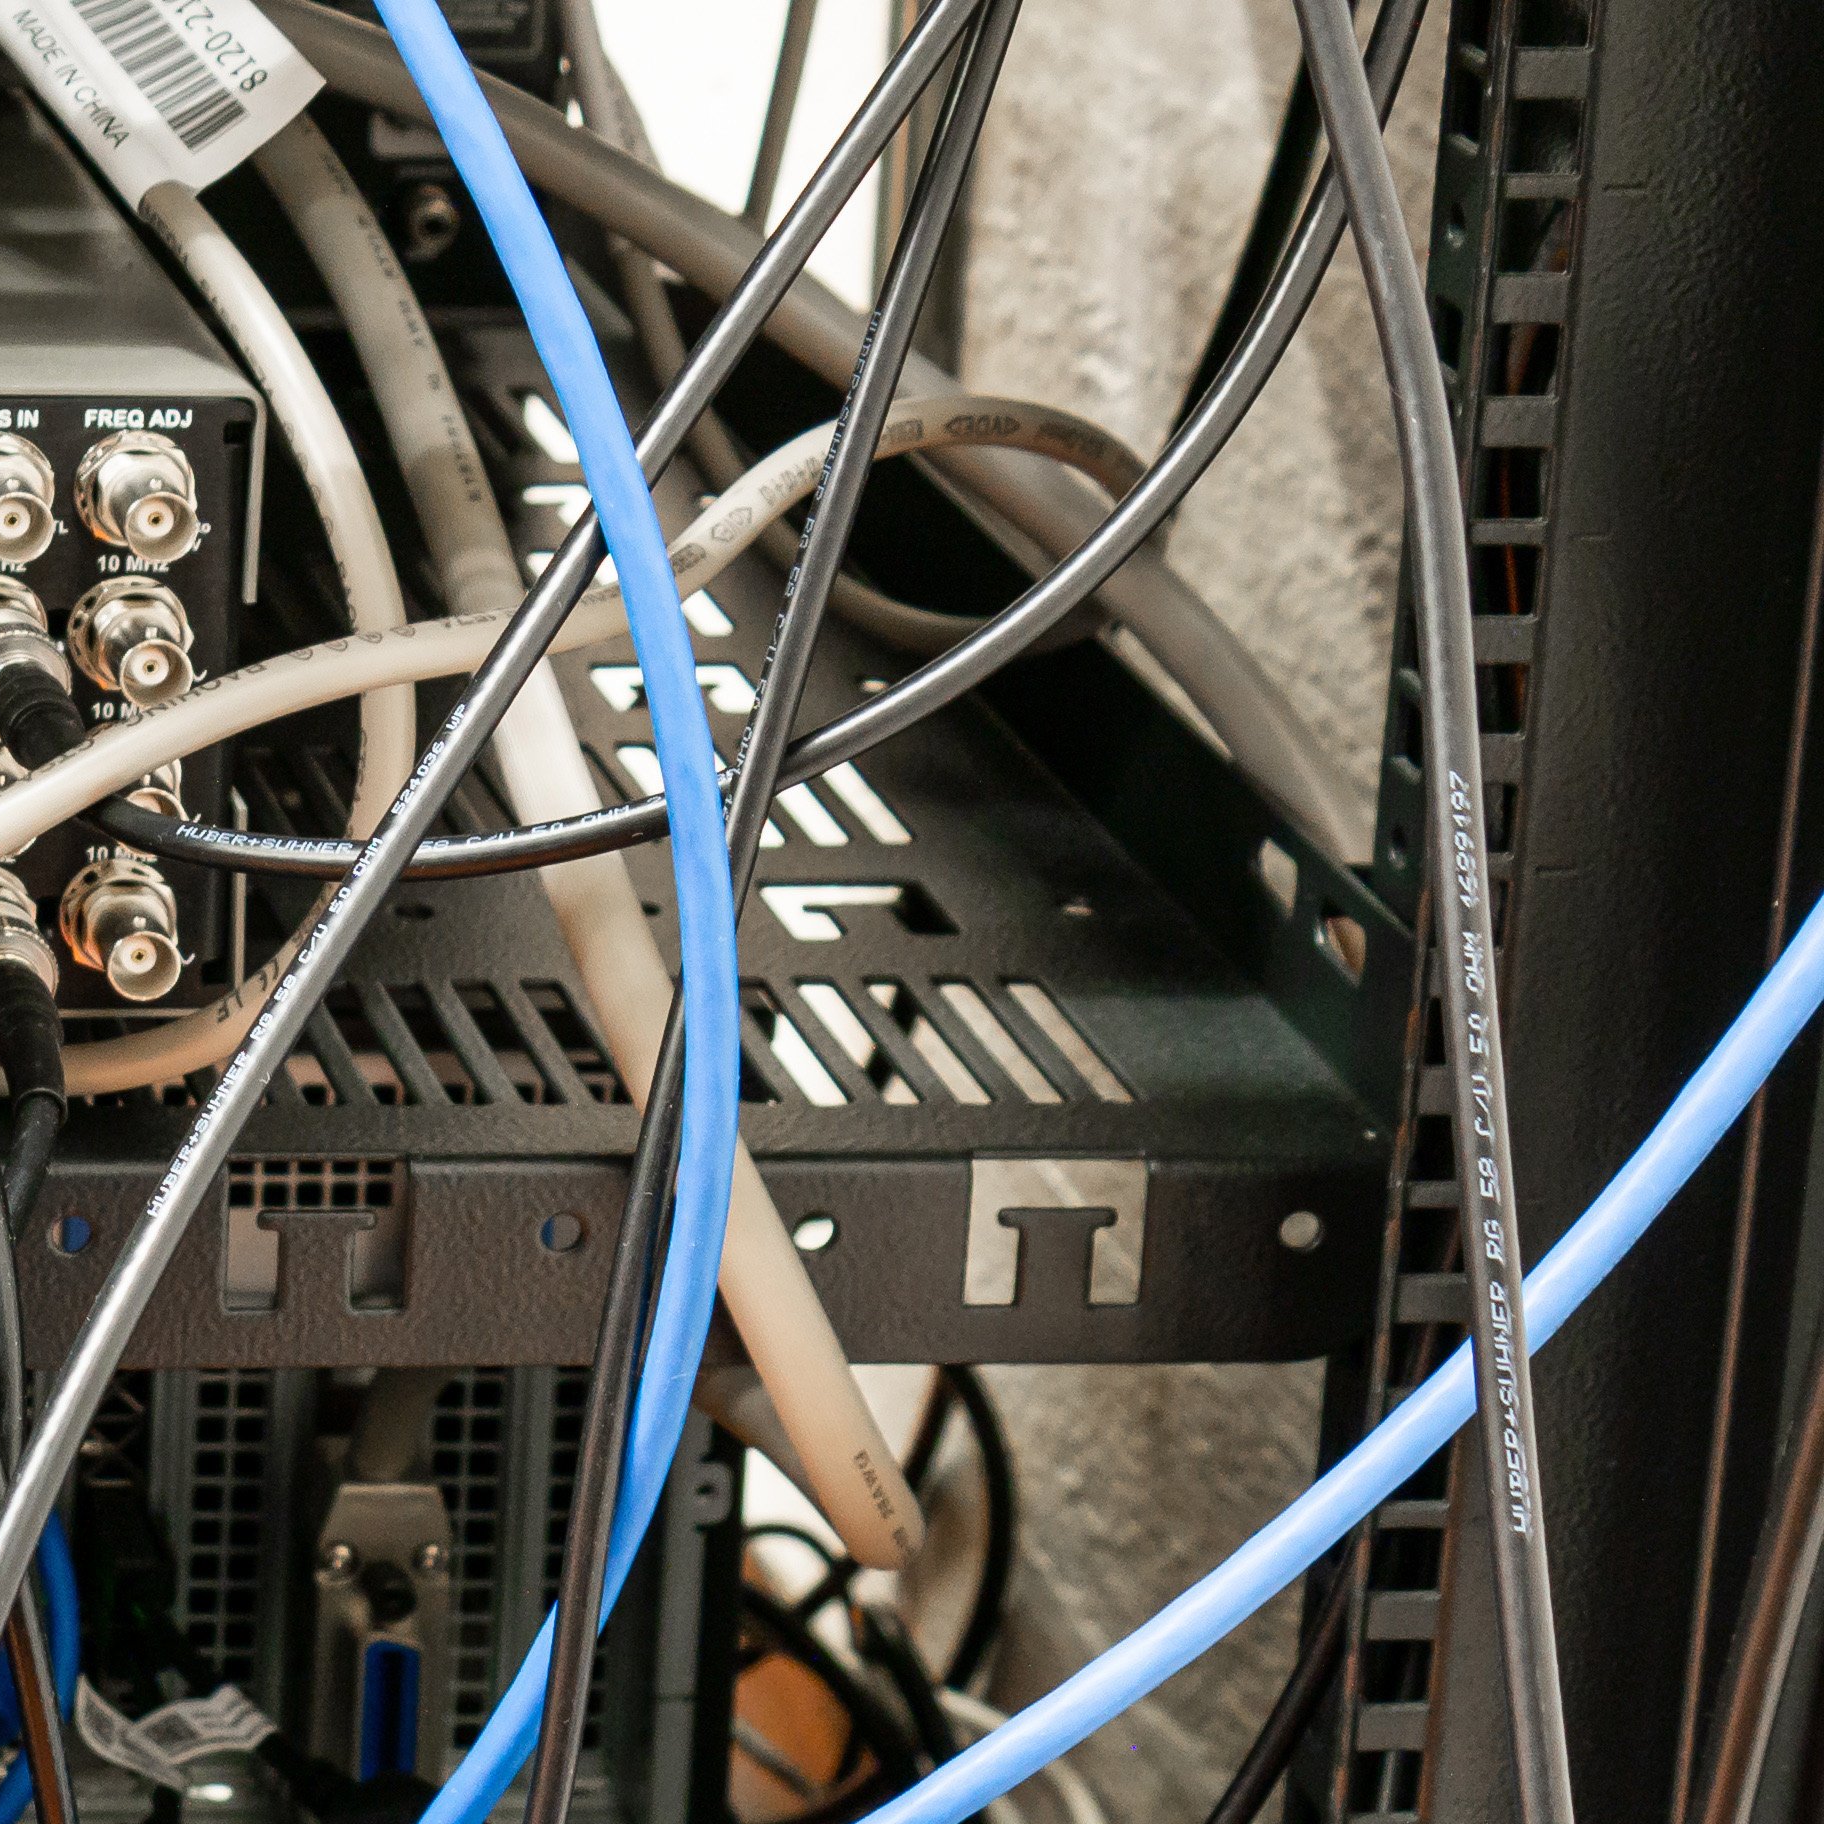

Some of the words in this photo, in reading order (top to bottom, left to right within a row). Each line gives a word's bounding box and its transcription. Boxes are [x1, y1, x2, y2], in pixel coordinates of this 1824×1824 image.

[170, 0, 268, 92] 8120-21
[13, 9, 65, 64] MADE
[55, 63, 81, 86] IN
[74, 86, 130, 150] CHINA
[17, 409, 39, 427] IN
[85, 409, 144, 429] FREQ
[149, 409, 193, 427] ADJ
[97, 555, 119, 572] 10
[91, 702, 114, 718] 10
[176, 824, 353, 855] HUBER+SUHNER
[87, 847, 109, 862] 10
[147, 1049, 250, 1218] HUBER+SUHNER
[250, 1013, 273, 1041] RG
[297, 924, 328, 963] C/U
[330, 886, 352, 916] 50
[353, 837, 383, 879] OHM
[391, 740, 445, 817] 524036
[446, 703, 467, 731] WP
